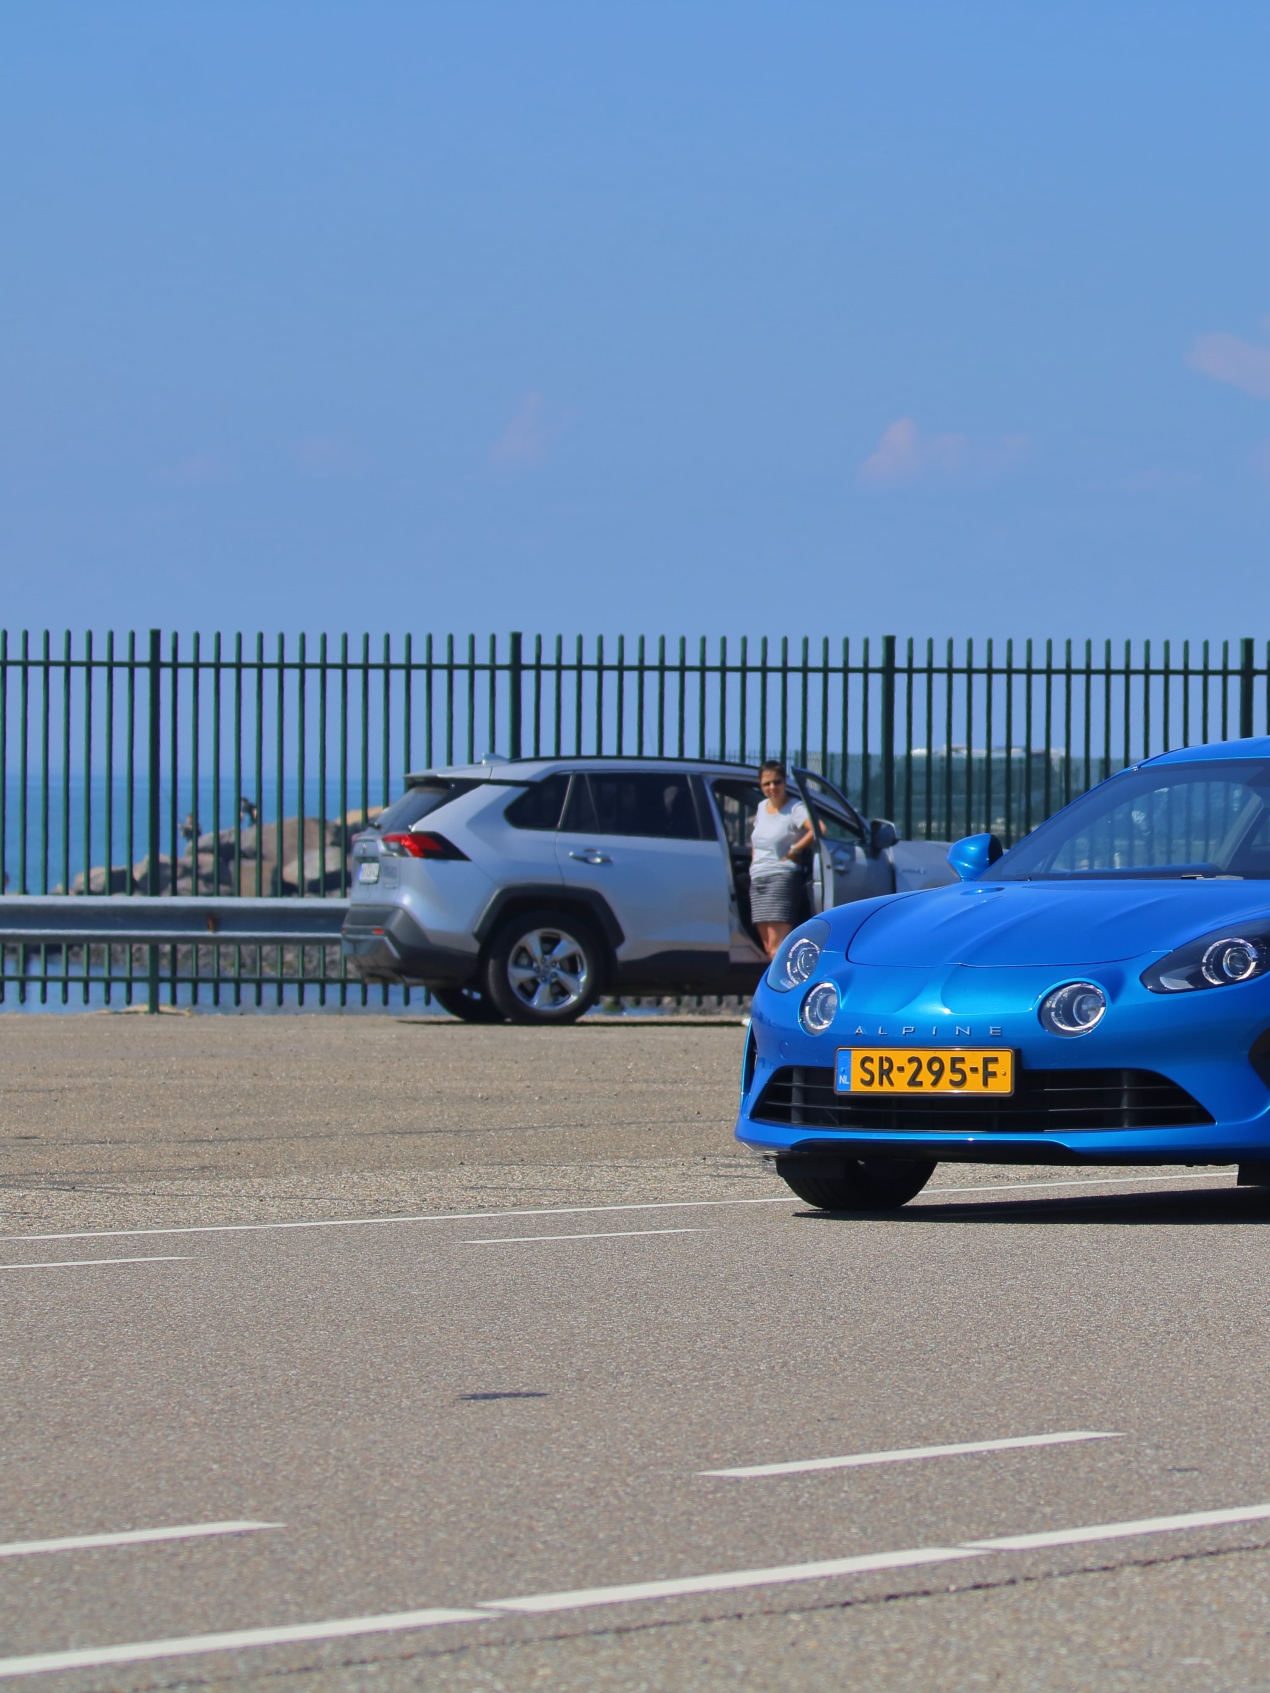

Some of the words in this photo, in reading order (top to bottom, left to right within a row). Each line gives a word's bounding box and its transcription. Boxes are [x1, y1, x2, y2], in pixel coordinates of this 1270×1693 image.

[854, 1025, 1002, 1036] ALPINE
[859, 1055, 999, 1087] SR-295-F
[838, 1074, 850, 1085] NL
